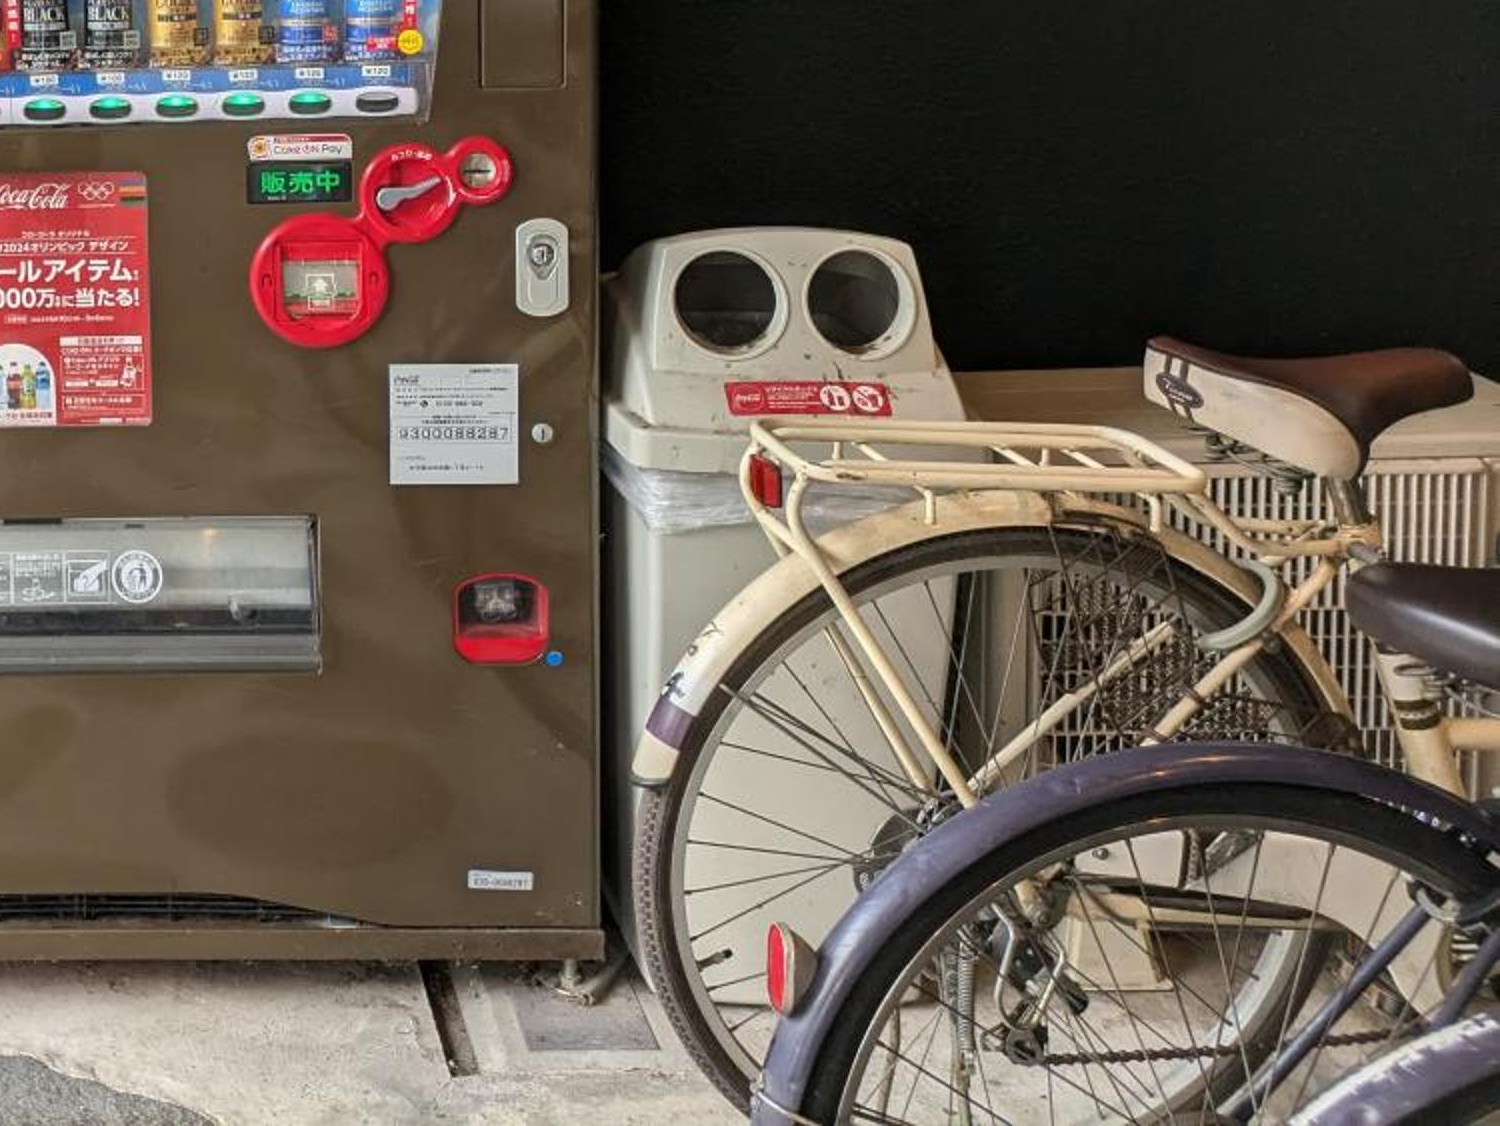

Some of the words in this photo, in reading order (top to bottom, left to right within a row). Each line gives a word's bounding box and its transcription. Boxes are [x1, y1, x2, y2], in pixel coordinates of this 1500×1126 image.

[23, 6, 67, 21] BLACK
[87, 6, 129, 21] BLACK
[365, 65, 389, 75] ¥120
[321, 144, 344, 155] Pay
[261, 170, 340, 194] 販売中
[89, 240, 129, 251] デザイン
